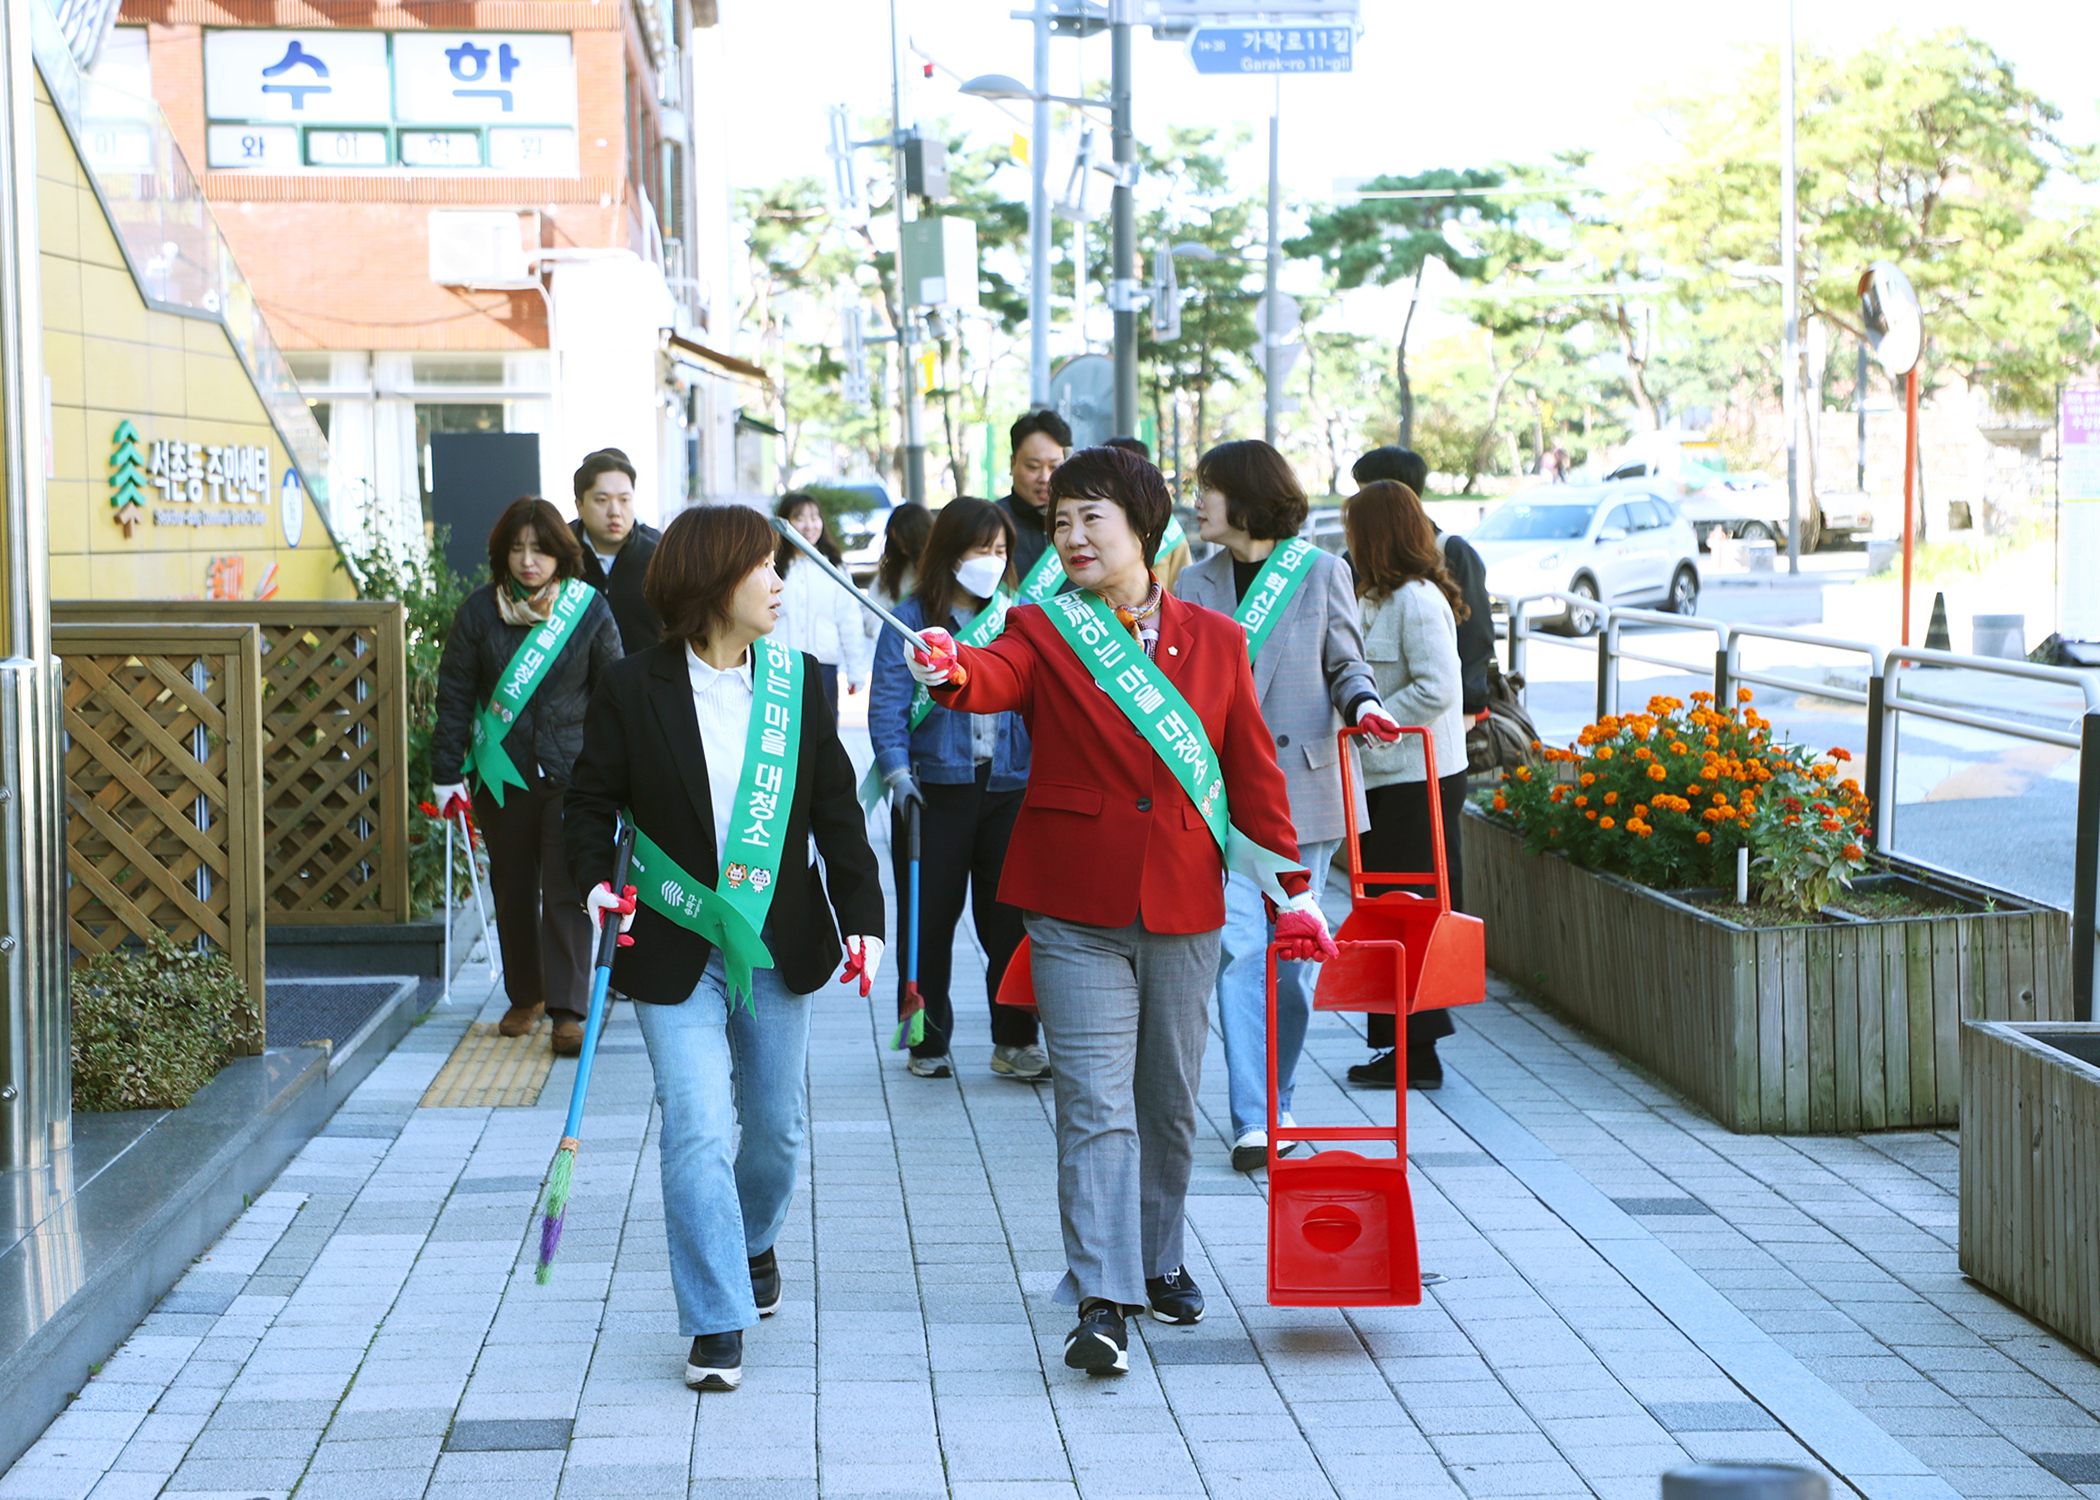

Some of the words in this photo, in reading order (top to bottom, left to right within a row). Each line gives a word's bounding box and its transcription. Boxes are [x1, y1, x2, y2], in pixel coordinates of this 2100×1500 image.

[1241, 56, 1306, 72] Garak-ro
[1308, 56, 1350, 73] 11-gil
[1243, 29, 1349, 54] 가락로11길
[151, 438, 205, 504] 석촌동
[206, 443, 271, 505] 주민센터
[536, 613, 566, 651] 마을
[504, 647, 545, 699] 대청소
[1053, 592, 1126, 669] 함께하는
[1115, 663, 1166, 715] 마을
[1155, 709, 1209, 785] 대청소
[760, 702, 791, 757] 마을
[741, 763, 783, 847] 대청소
